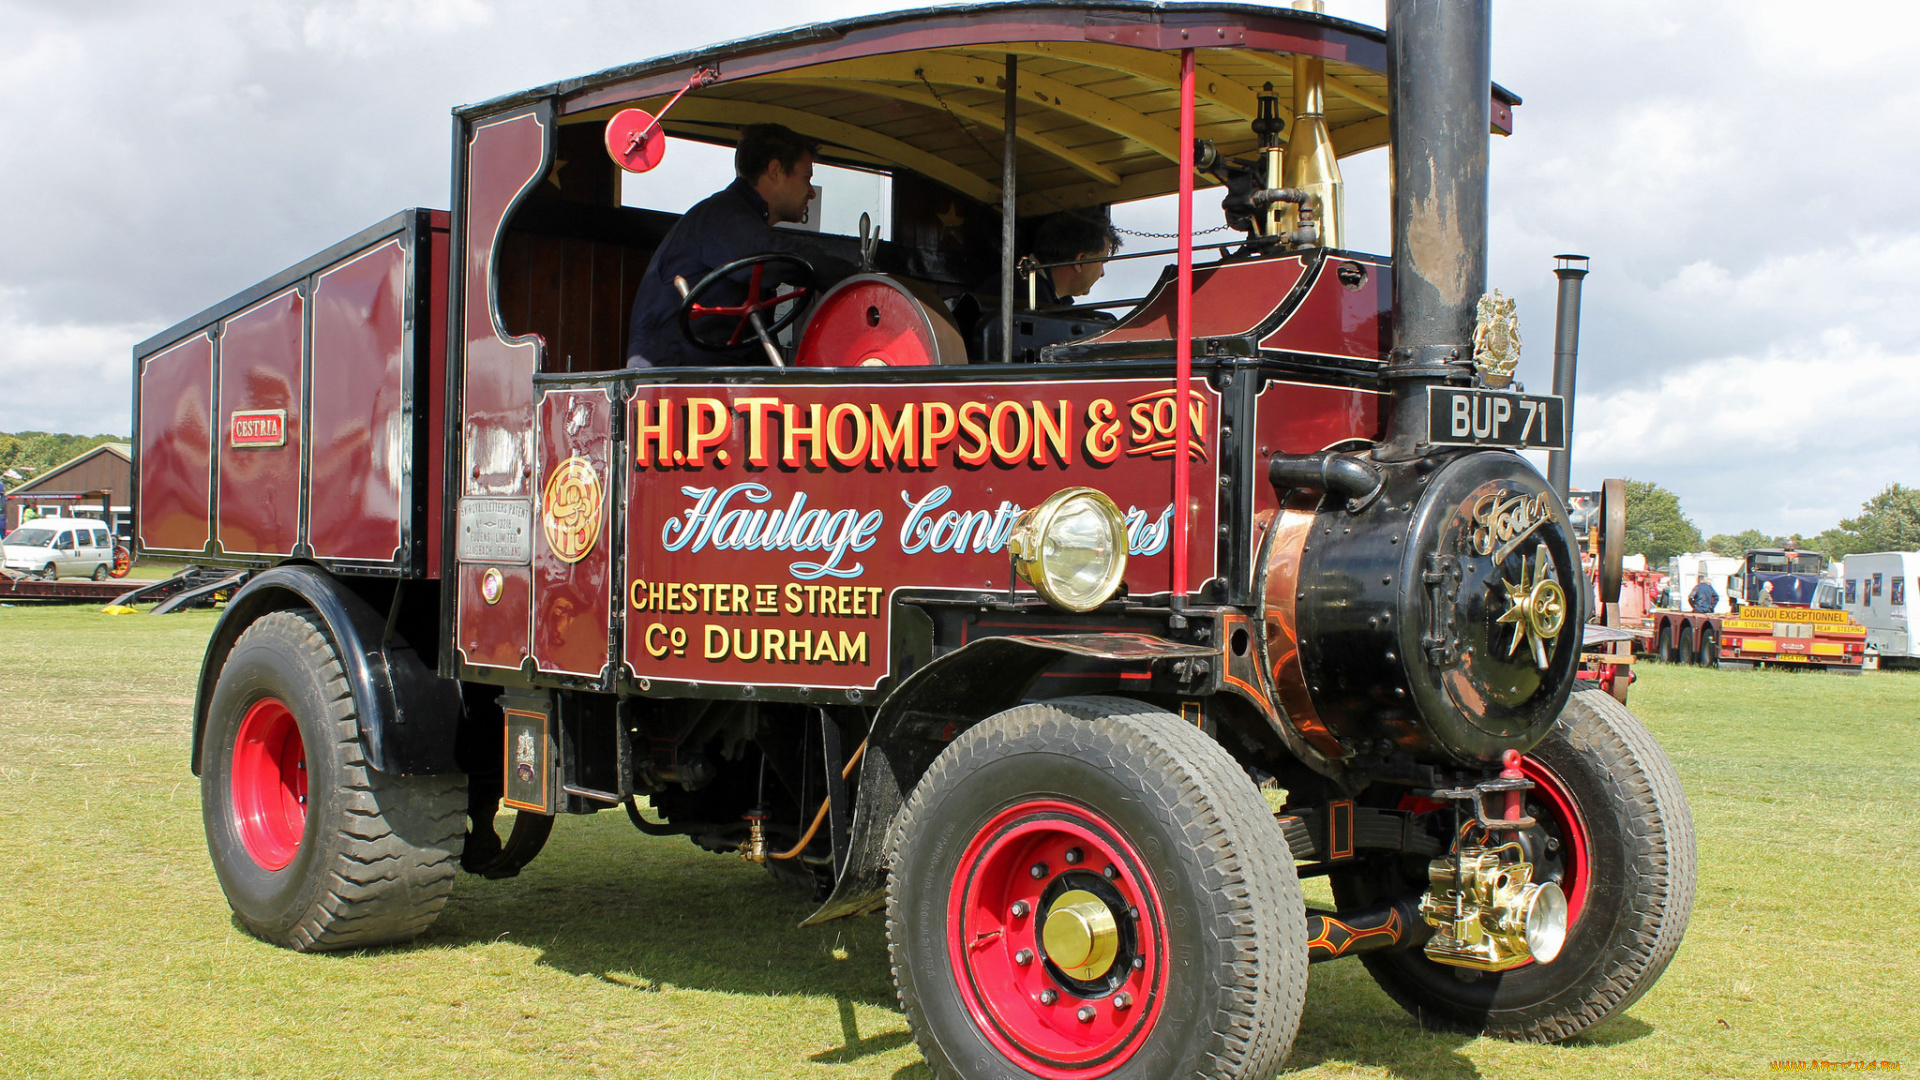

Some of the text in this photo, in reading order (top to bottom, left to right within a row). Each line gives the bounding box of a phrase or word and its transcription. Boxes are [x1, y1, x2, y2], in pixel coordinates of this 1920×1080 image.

[236, 420, 278, 437] CESTRIA
[1085, 398, 1123, 464] &
[1130, 394, 1208, 445] SON
[1451, 394, 1548, 443] BUP 71
[662, 482, 884, 580] Haulage
[1473, 488, 1559, 565] Foden
[630, 578, 884, 617] CHESTER LE STREET
[1743, 608, 1844, 623] CONVOI EXCEPTIONNEL
[703, 623, 868, 664] DURHAM
[1744, 621, 1772, 630] STEERING
[1816, 624, 1864, 634] REAR STEERING
